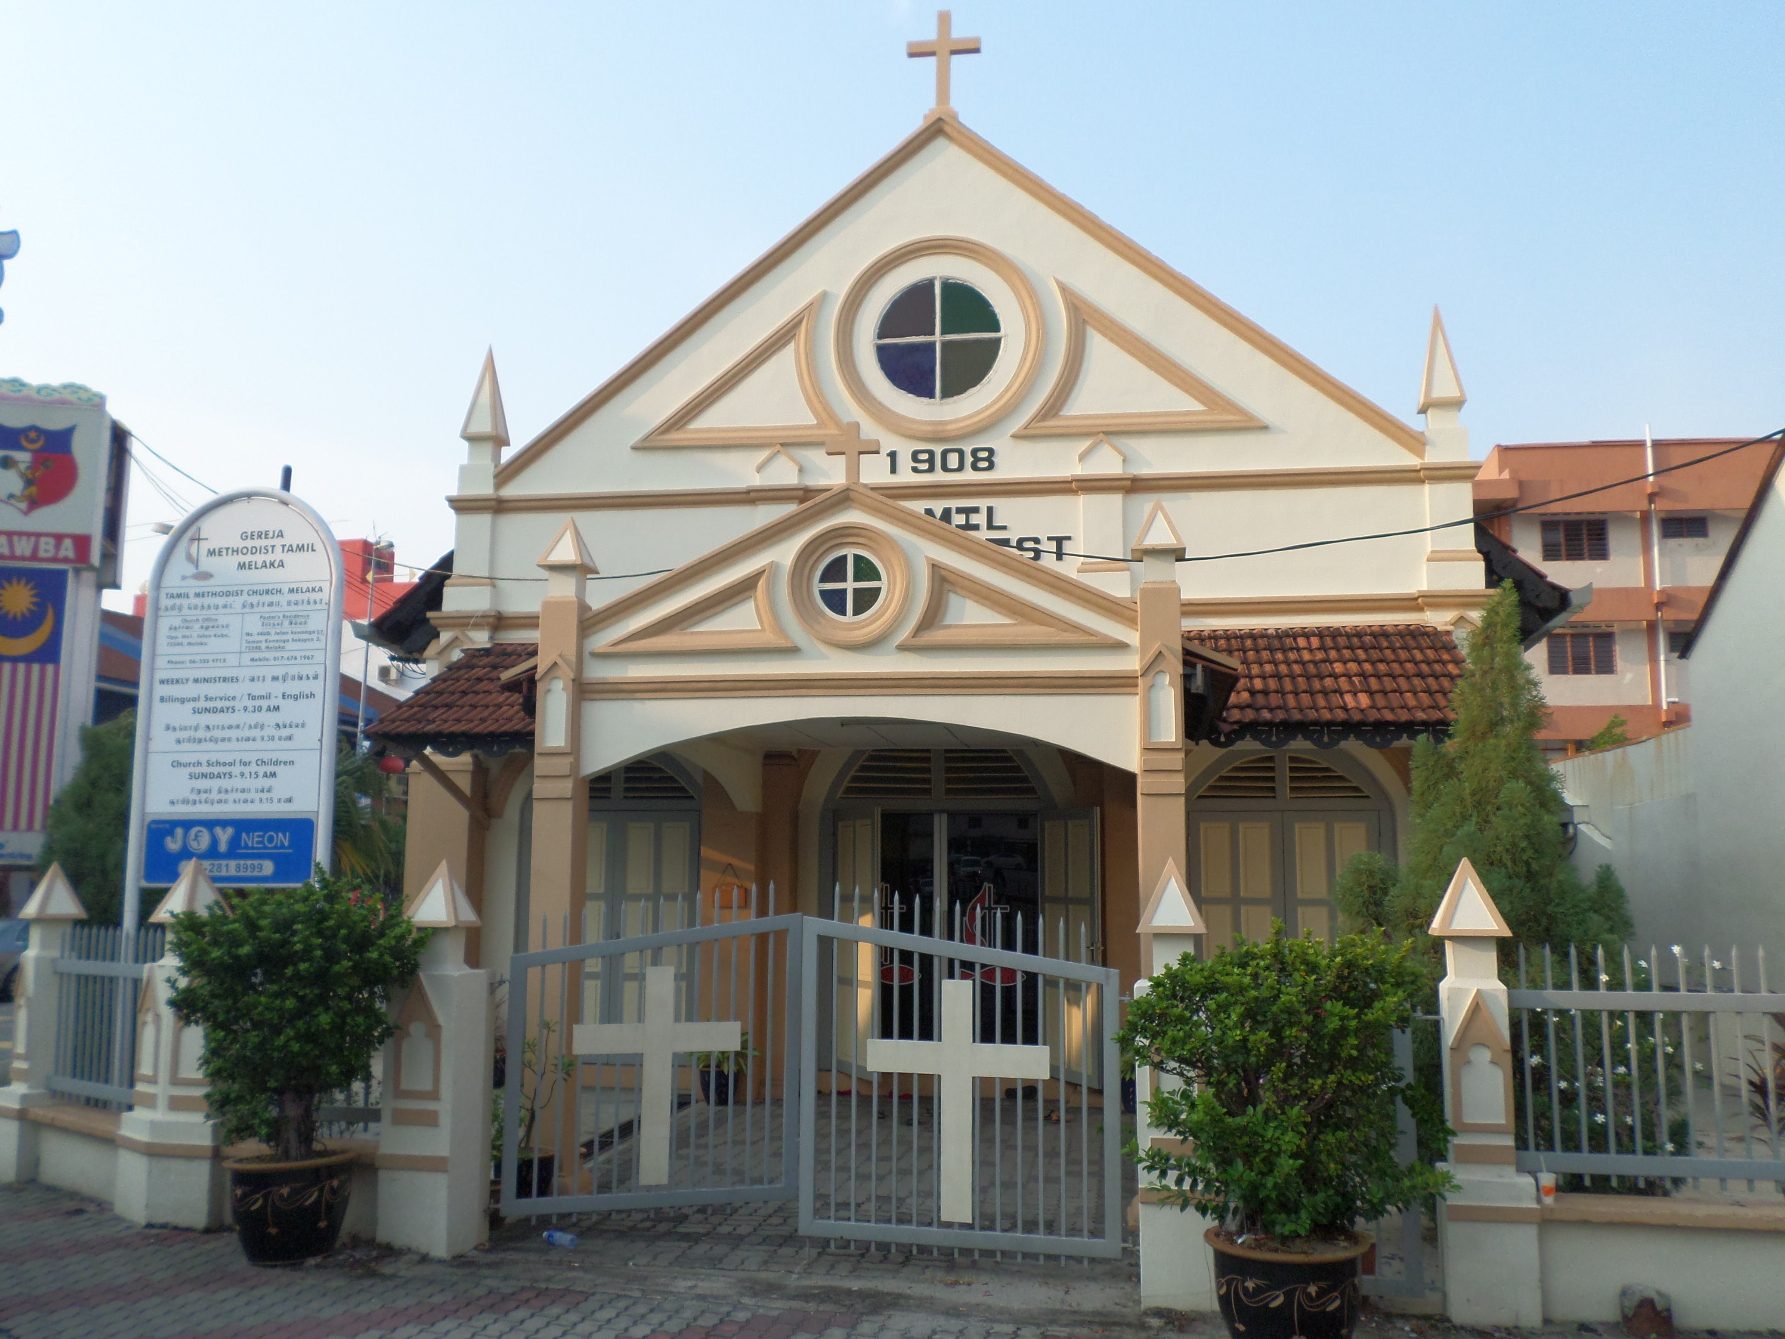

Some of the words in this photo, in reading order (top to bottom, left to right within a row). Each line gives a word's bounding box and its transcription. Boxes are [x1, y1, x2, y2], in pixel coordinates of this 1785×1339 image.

[885, 447, 996, 475] 1908
[240, 529, 284, 541] GEREJA
[206, 545, 276, 557] METHODIST
[280, 543, 317, 554] TAMIL
[237, 559, 285, 571] MELAKA
[165, 591, 190, 600] TAMIL
[193, 589, 244, 599] METHODIST
[246, 587, 284, 597] CHURCH,
[287, 586, 323, 594] MELAKA
[158, 678, 189, 686] WEEKLY
[192, 676, 239, 685] MINISTRIES
[159, 695, 200, 705] Bilingual
[203, 693, 237, 703] Service
[247, 692, 271, 701] Tamil
[281, 691, 316, 702] English
[191, 706, 236, 715] SUNDAYS
[243, 705, 262, 714] 9.30
[265, 704, 280, 713] AM
[170, 760, 202, 768] Church
[206, 759, 236, 768] School
[239, 759, 252, 767] for
[255, 758, 295, 767] Children
[188, 771, 233, 780] SUNDAYS
[239, 771, 259, 779] 9.15
[262, 770, 277, 779] AM
[241, 831, 290, 848] NEON
[234, 862, 263, 873] 8999
